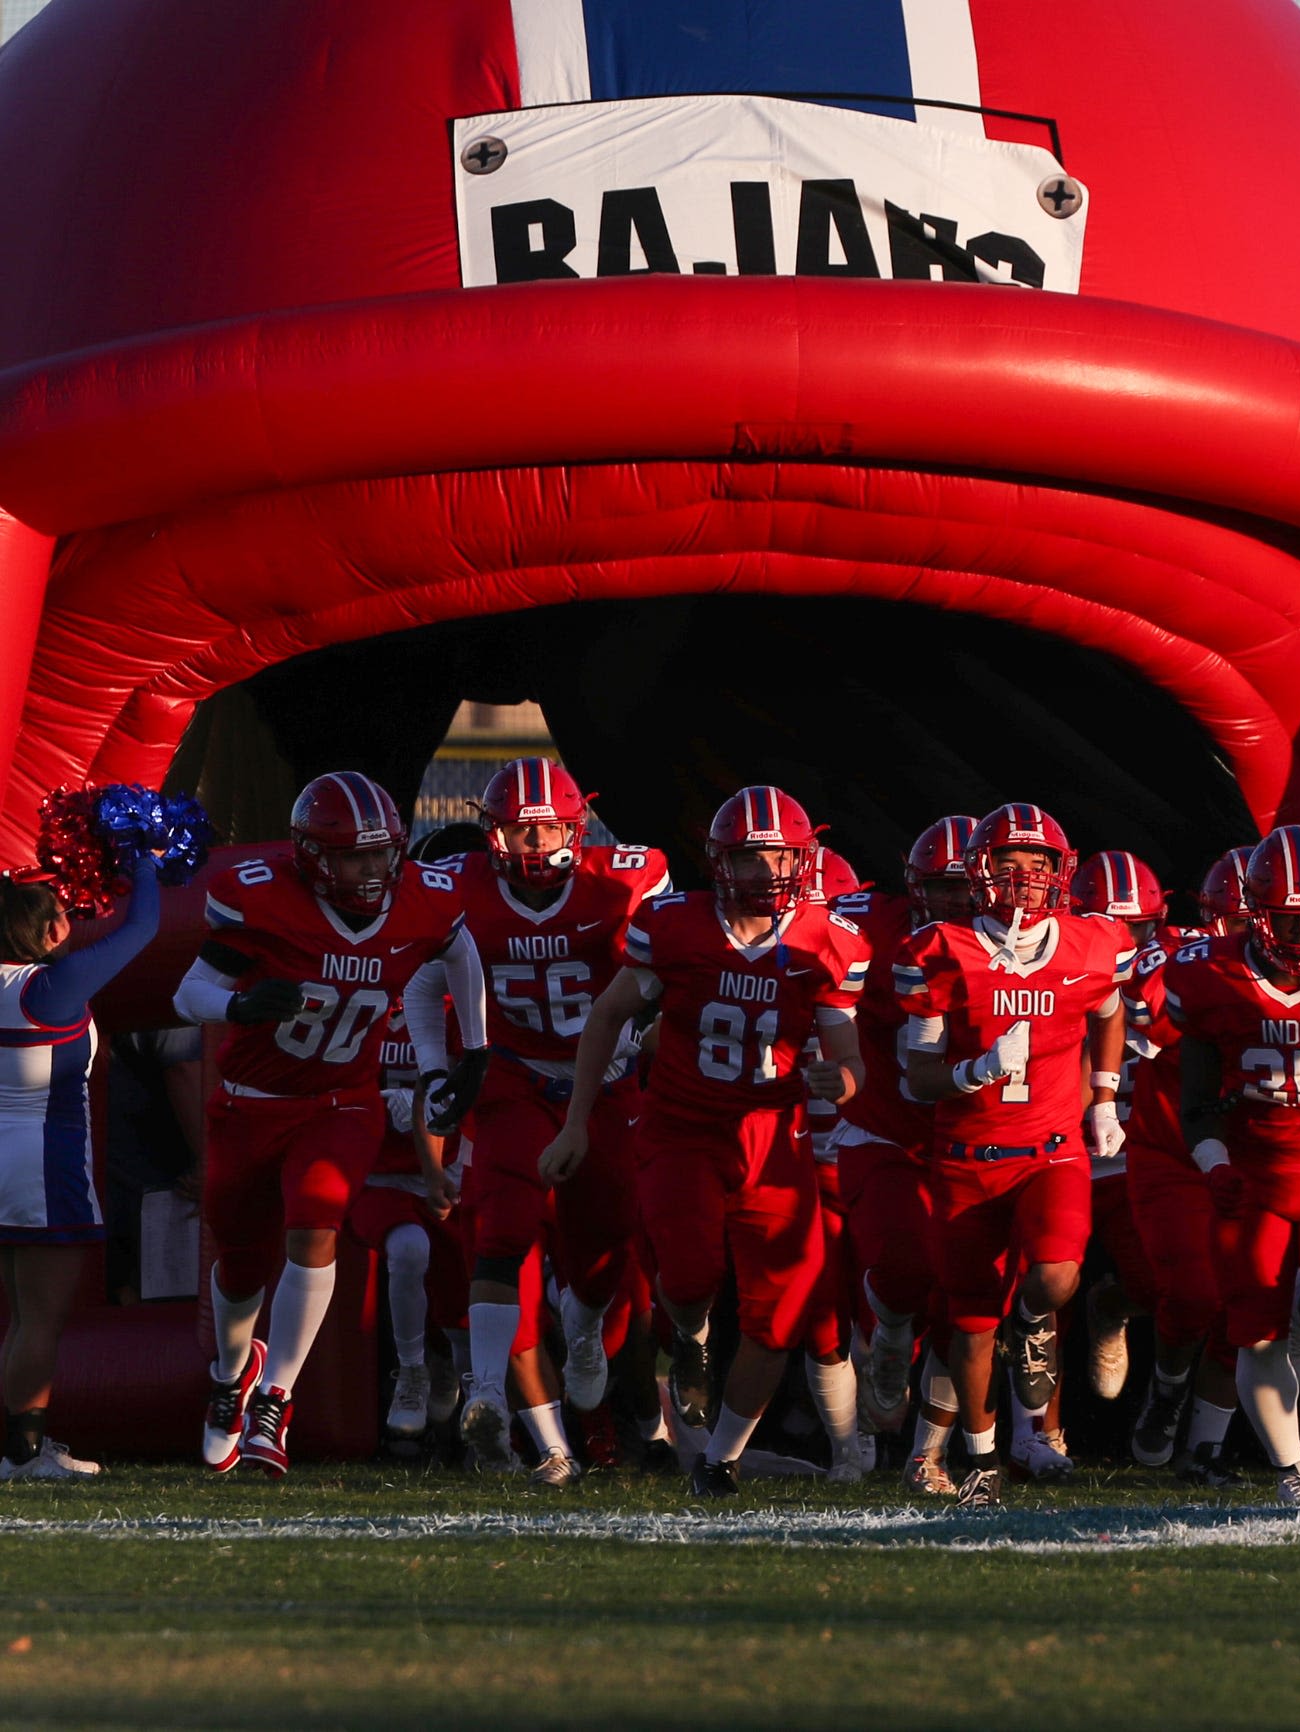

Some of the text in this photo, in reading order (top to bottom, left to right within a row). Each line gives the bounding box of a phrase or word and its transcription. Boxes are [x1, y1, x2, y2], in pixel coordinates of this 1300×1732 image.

[523, 808, 552, 816] Riddell
[750, 832, 780, 840] Riddell
[507, 935, 570, 961] INDIO
[321, 953, 383, 984] INDIO
[491, 961, 593, 1038] 56
[718, 971, 778, 1003] INDIO
[993, 989, 1055, 1017] INDIO
[274, 981, 390, 1063] 80
[698, 1001, 779, 1084] 81
[1001, 1020, 1031, 1103] 1
